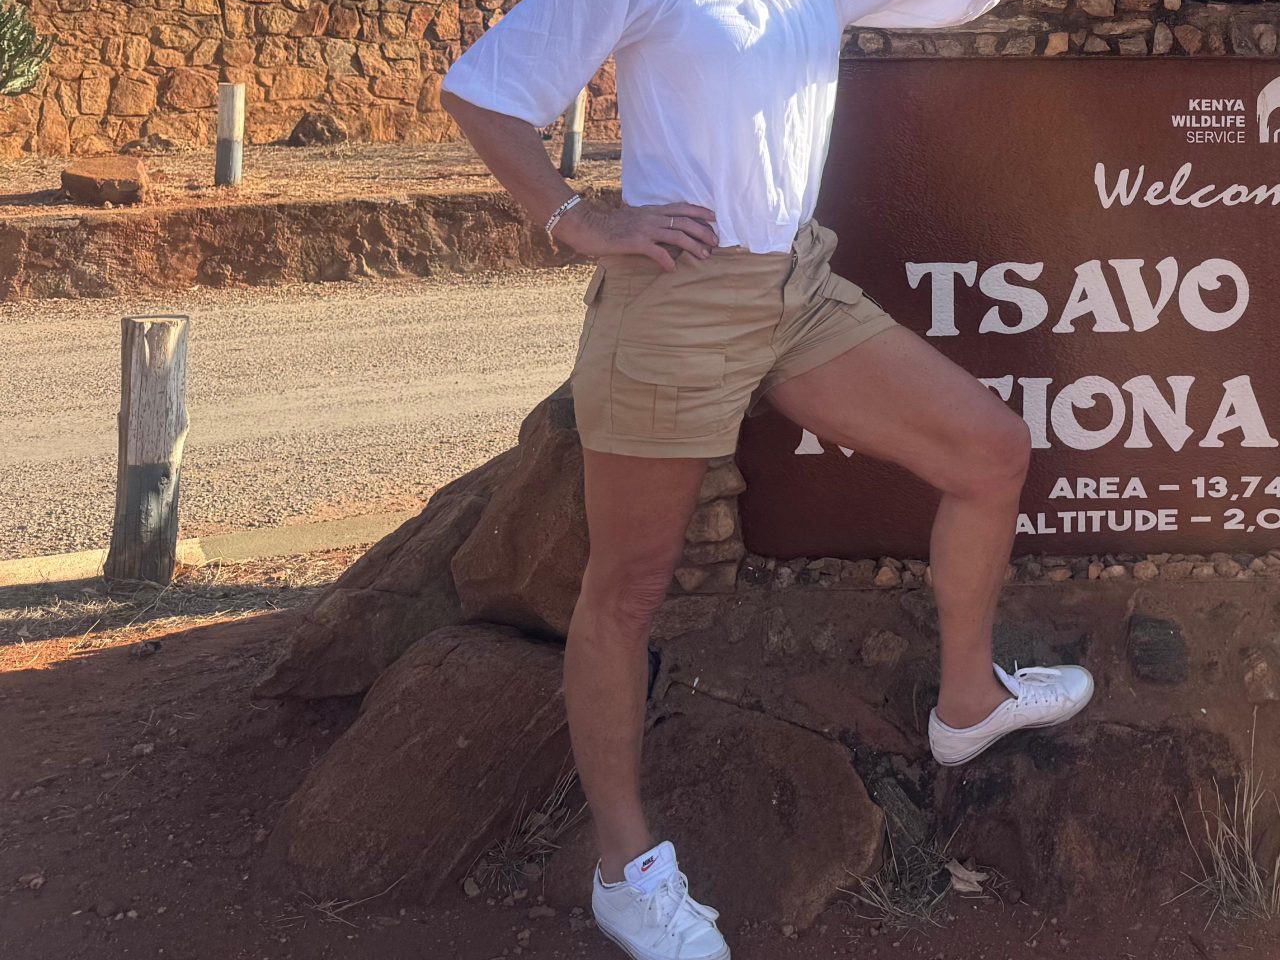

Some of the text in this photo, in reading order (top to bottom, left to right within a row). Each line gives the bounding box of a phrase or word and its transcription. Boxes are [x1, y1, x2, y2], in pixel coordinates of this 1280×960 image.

[1188, 98, 1246, 112] KENYA
[1171, 114, 1246, 128] WILDLIFE
[1186, 130, 1246, 144] SERVICE
[905, 256, 1250, 337] TSAVO
[1048, 476, 1148, 499] AREA
[1015, 508, 1179, 535] ALTITUDE
[642, 855, 654, 866] NIKE
